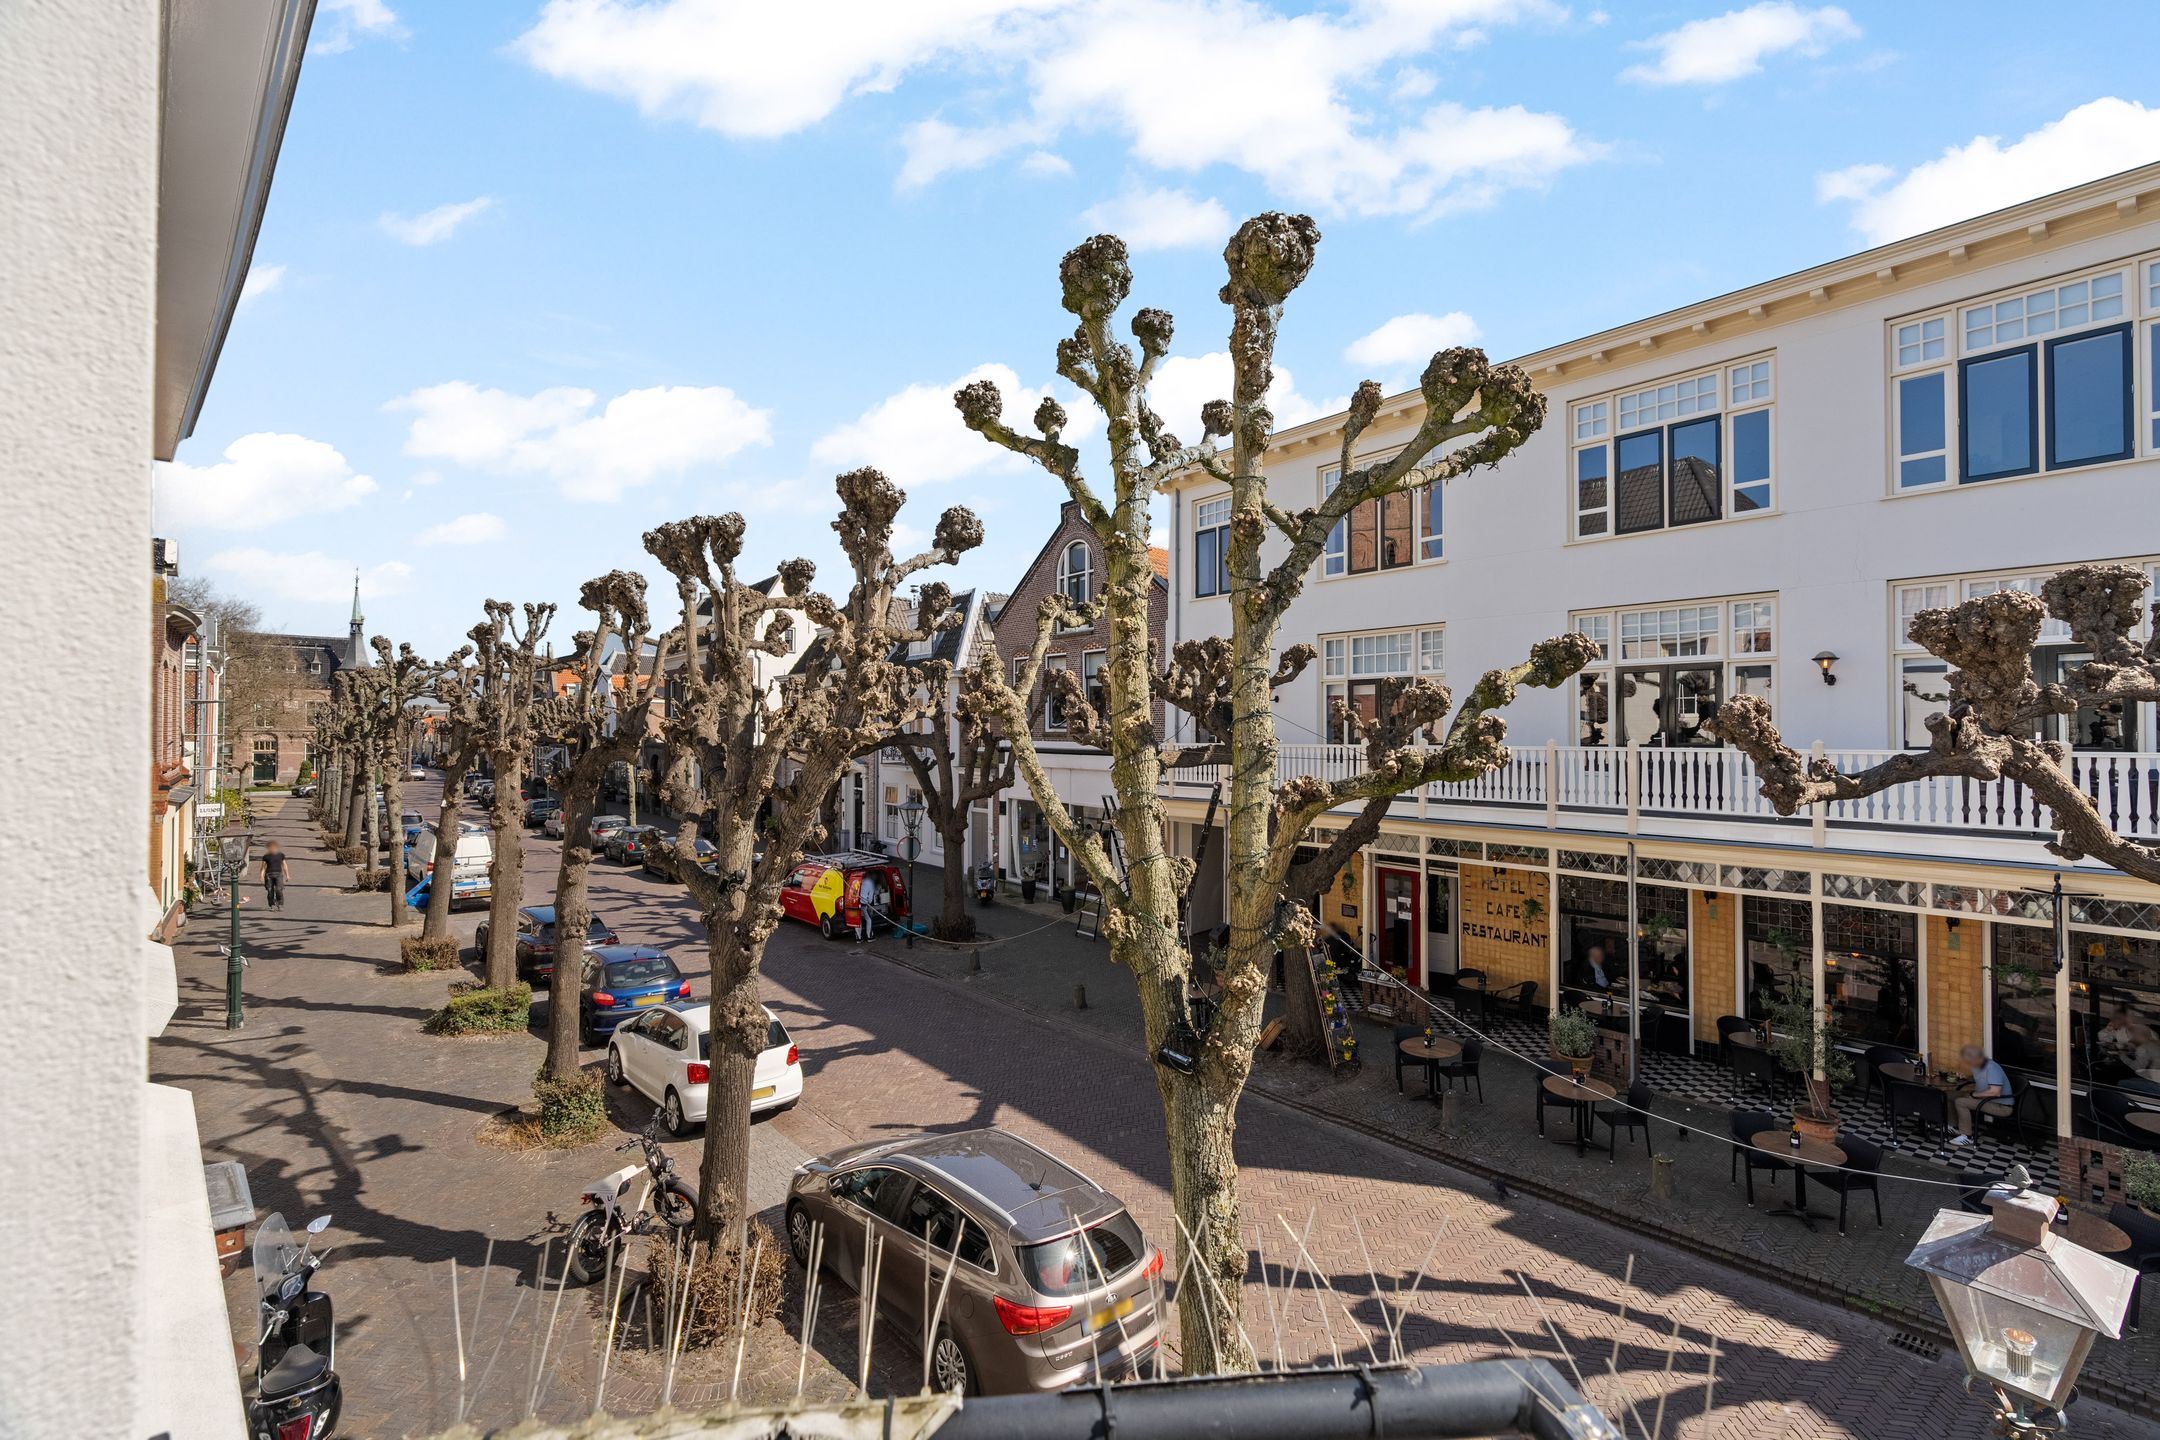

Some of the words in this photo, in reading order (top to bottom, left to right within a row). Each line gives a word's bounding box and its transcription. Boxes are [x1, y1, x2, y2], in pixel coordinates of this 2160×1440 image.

[1481, 879, 1525, 895] HOTEL
[1486, 901, 1521, 919] CAFE
[1462, 921, 1548, 948] RESTAURANT
